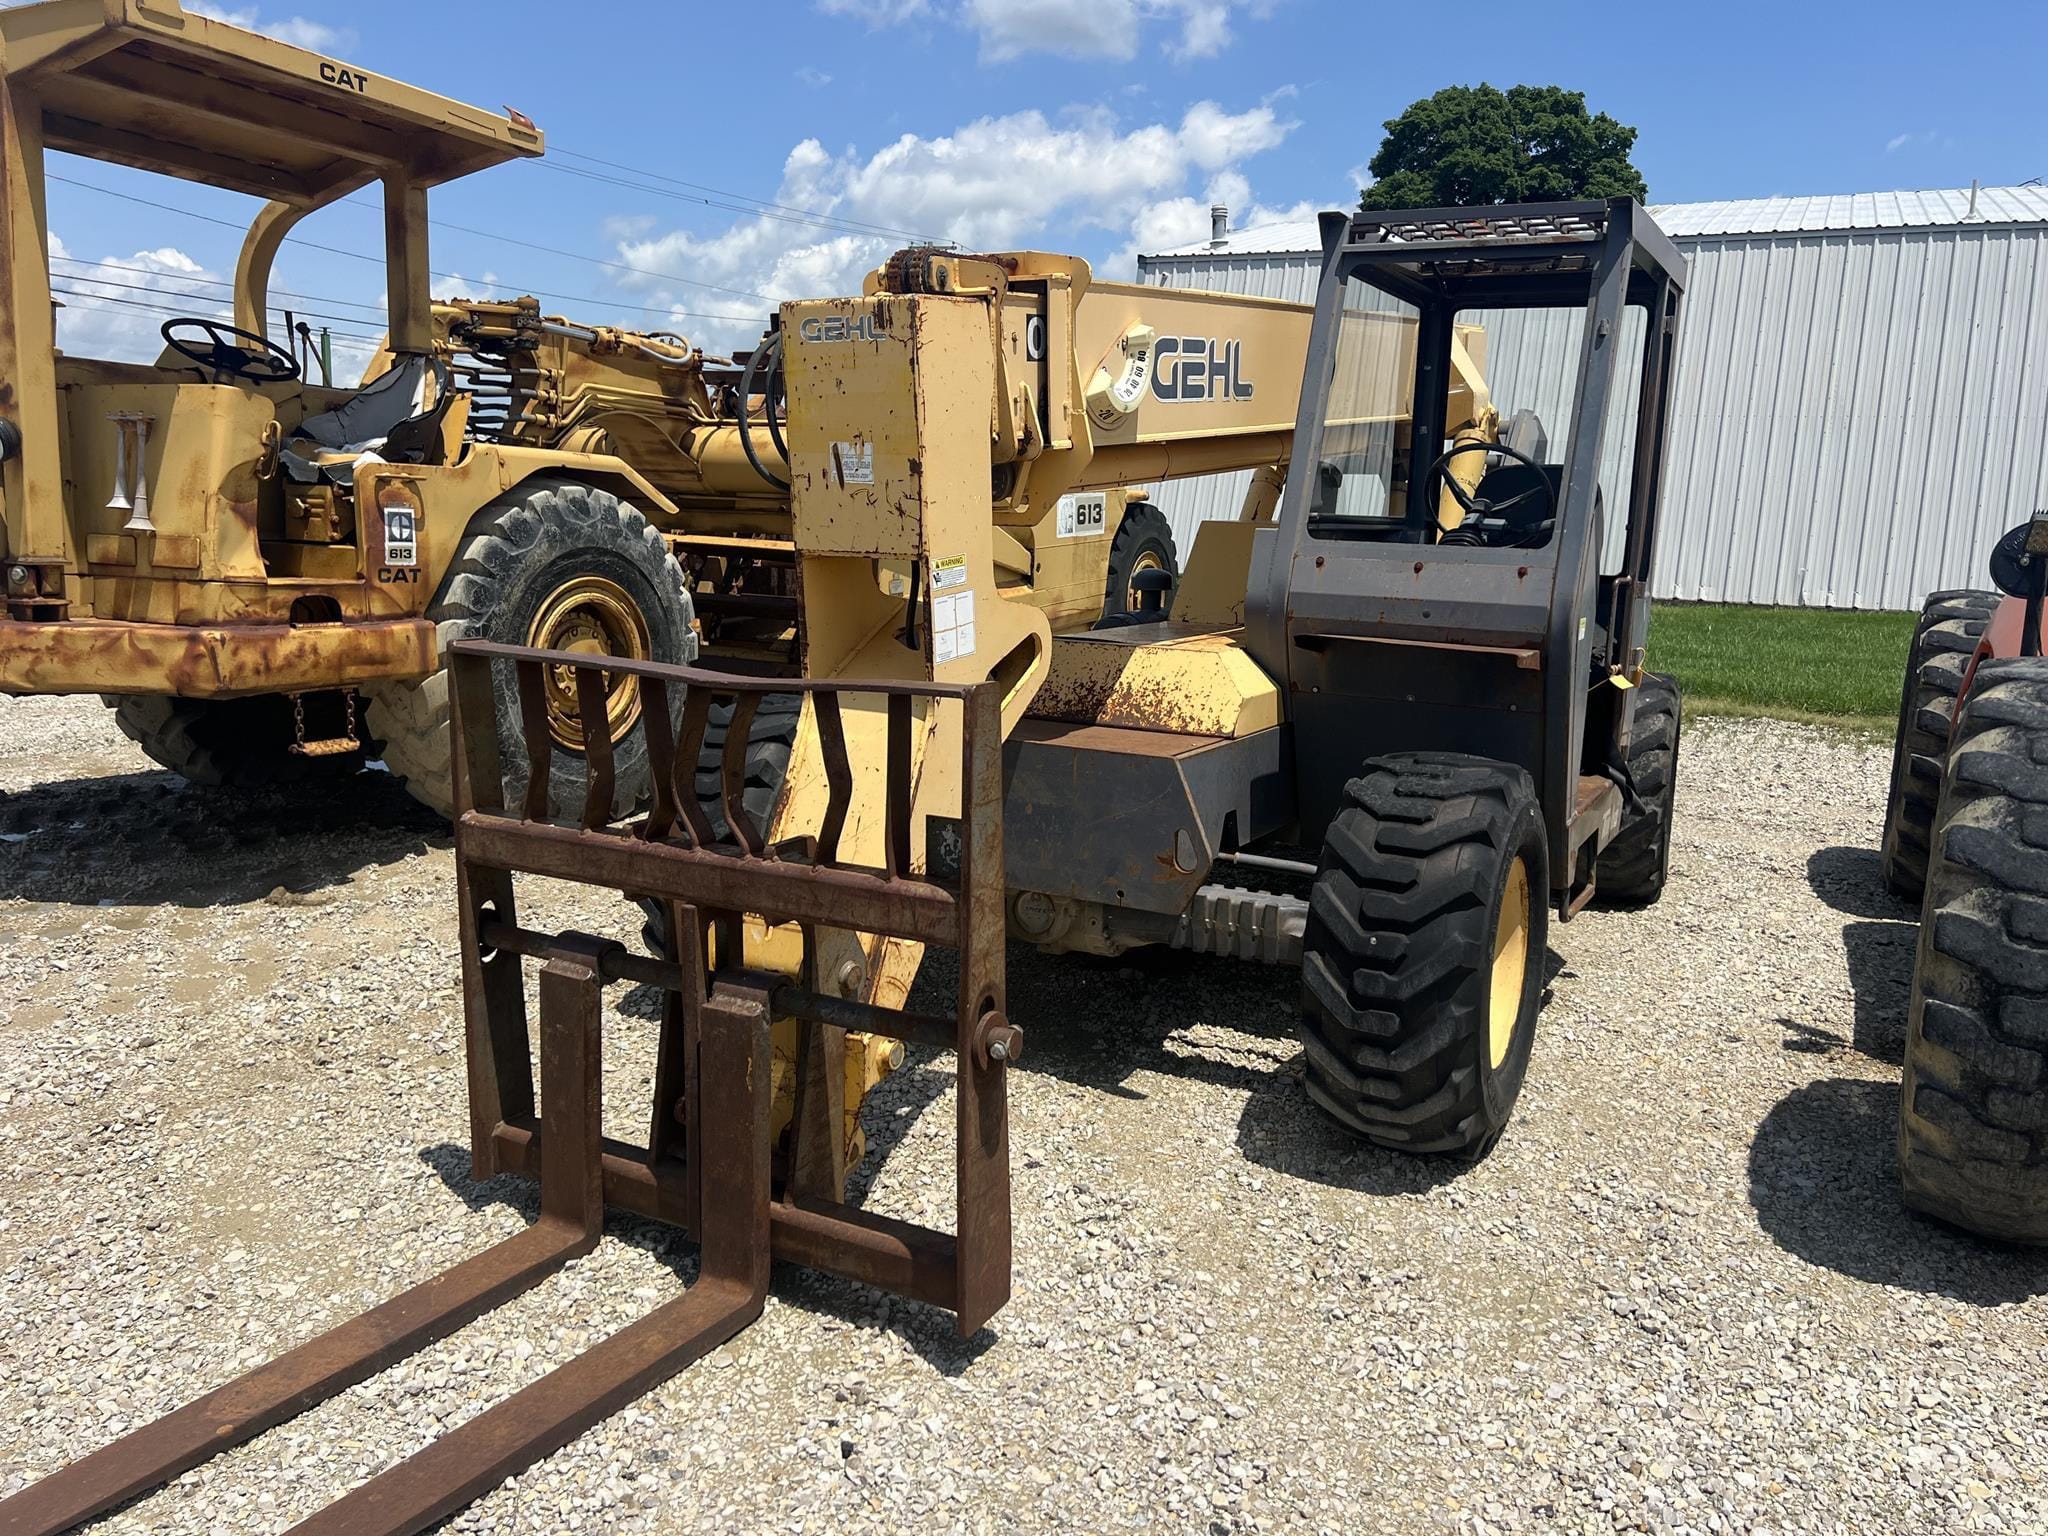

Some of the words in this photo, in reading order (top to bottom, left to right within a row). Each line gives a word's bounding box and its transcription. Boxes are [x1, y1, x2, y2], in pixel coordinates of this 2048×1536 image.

[319, 62, 368, 93] CAT
[800, 315, 887, 344] GEHL
[1137, 350, 1147, 362] 80
[1134, 366, 1144, 378] 60
[1150, 335, 1254, 404] GEHL
[1130, 379, 1140, 389] 40
[1076, 503, 1102, 525] 613
[389, 548, 412, 559] 613
[940, 556, 964, 568] WARNING
[377, 567, 422, 583] CAT
